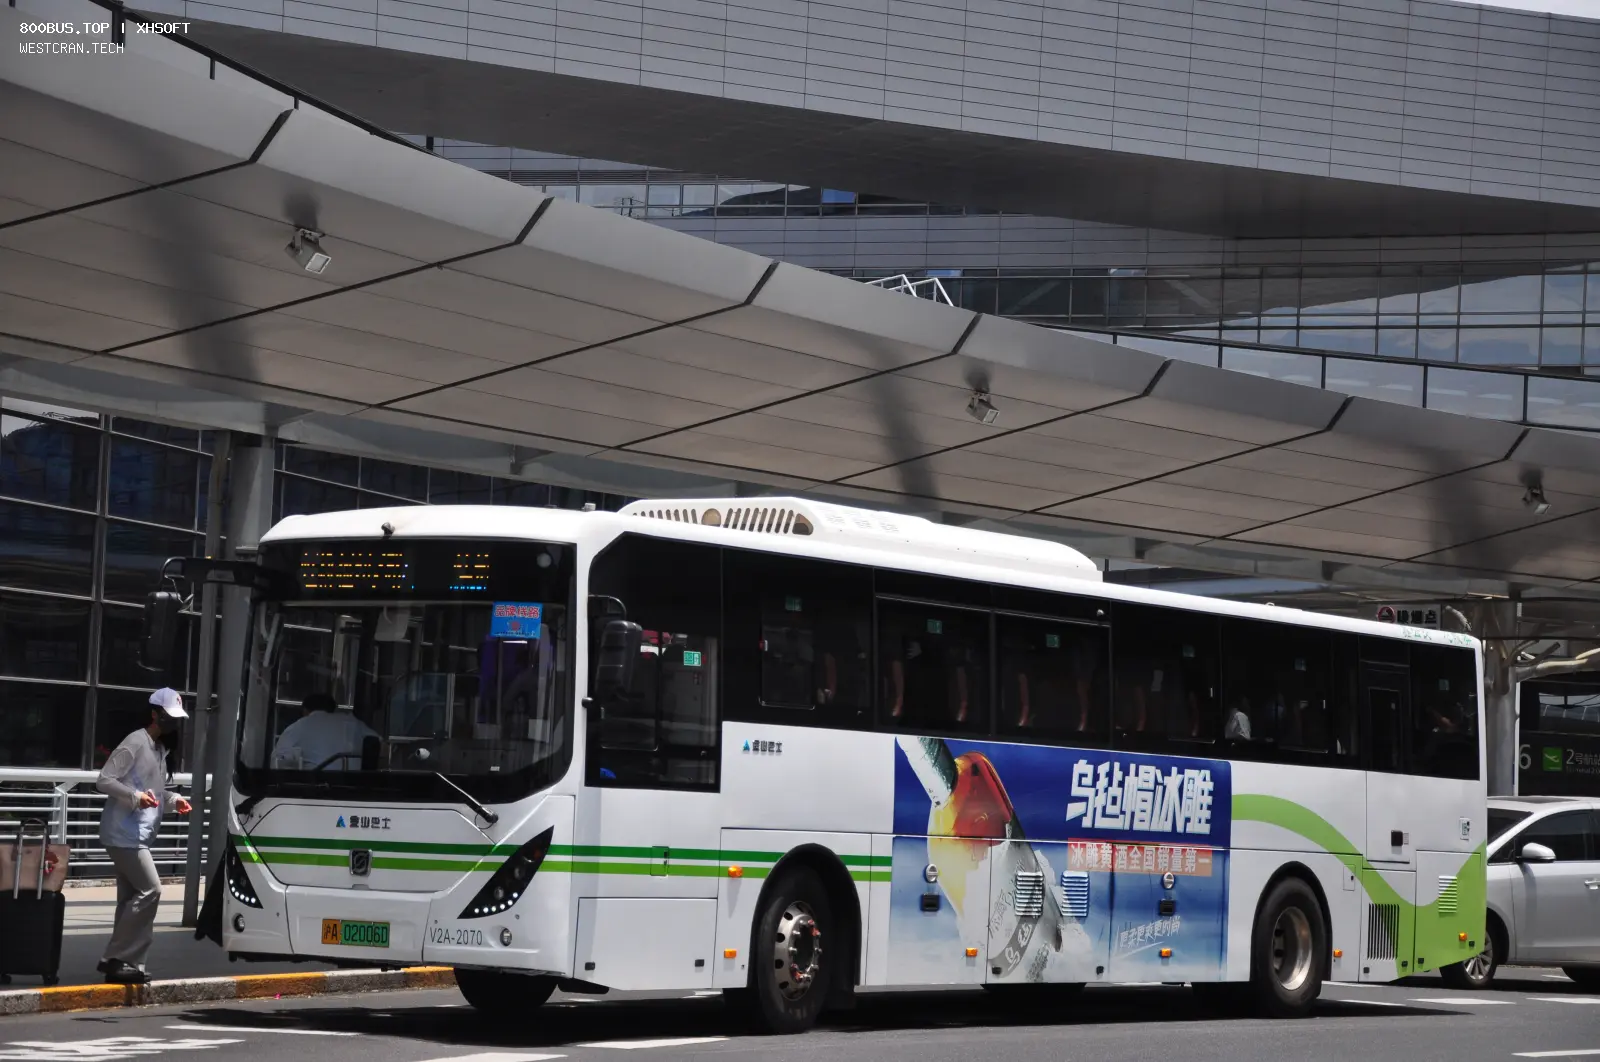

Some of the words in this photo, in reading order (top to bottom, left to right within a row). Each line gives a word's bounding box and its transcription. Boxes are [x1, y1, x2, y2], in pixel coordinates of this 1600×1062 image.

[494, 604, 540, 619] 品牌线路
[1065, 759, 1214, 835] 乌毡帽冰雕
[1070, 842, 1211, 876] 冰雕黄酒全国销量第一
[429, 926, 483, 946] V2A-2070
